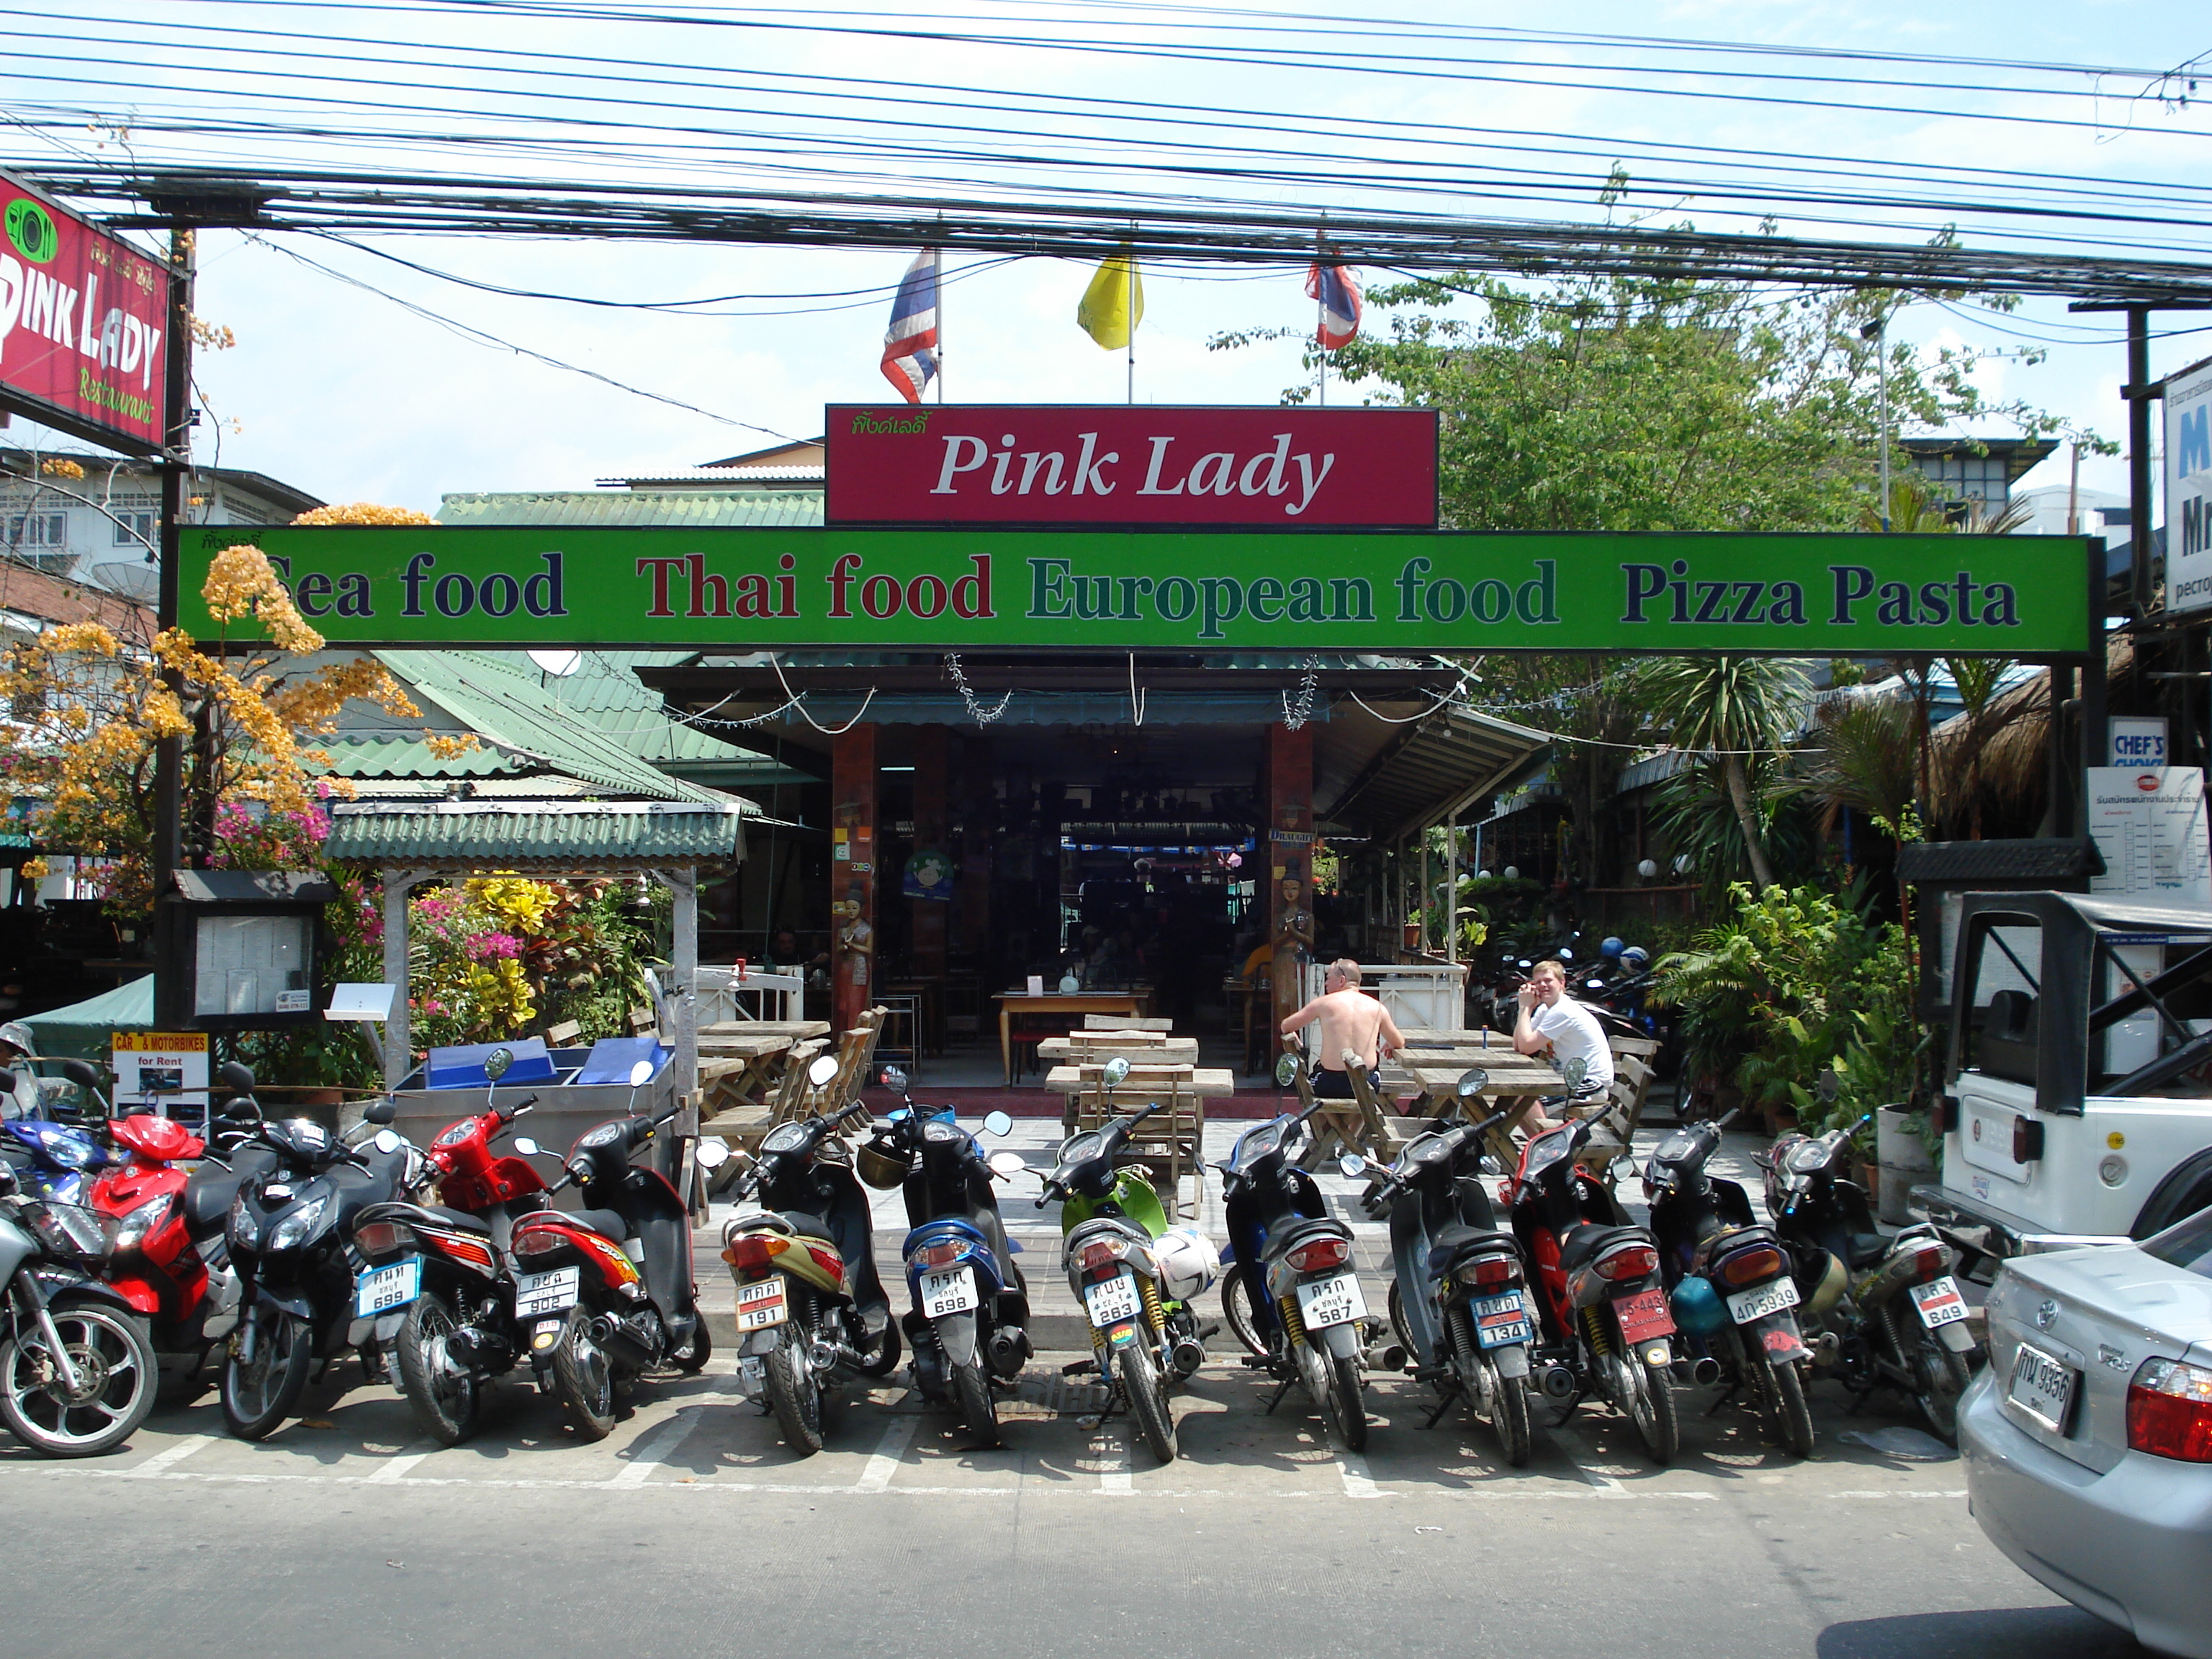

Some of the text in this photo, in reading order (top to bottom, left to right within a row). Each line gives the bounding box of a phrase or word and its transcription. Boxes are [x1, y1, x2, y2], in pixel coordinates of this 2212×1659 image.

[80, 271, 161, 391] LADY
[78, 367, 154, 425] Restaurant
[929, 432, 1335, 516] Pink Lady
[400, 552, 569, 618] food
[637, 552, 801, 619] Thai
[826, 553, 998, 619] food
[1025, 557, 1377, 639] European
[1395, 557, 1561, 624] food
[1620, 559, 1809, 626] Pizza
[1827, 565, 2021, 626] Pasta
[2176, 576, 2212, 604] ресто
[2115, 735, 2163, 755] CHEF'S
[116, 1036, 204, 1051] CAR & MOTORBIKES
[138, 1056, 182, 1066] for Rent
[374, 1290, 403, 1309] 699
[531, 1295, 560, 1313] 902
[935, 1296, 967, 1313] 698
[747, 1308, 775, 1326] 191
[1100, 1303, 1133, 1324] 263
[1318, 1305, 1350, 1323] 587
[1490, 1324, 1522, 1341] 134
[2038, 1360, 2069, 1402] 9356
